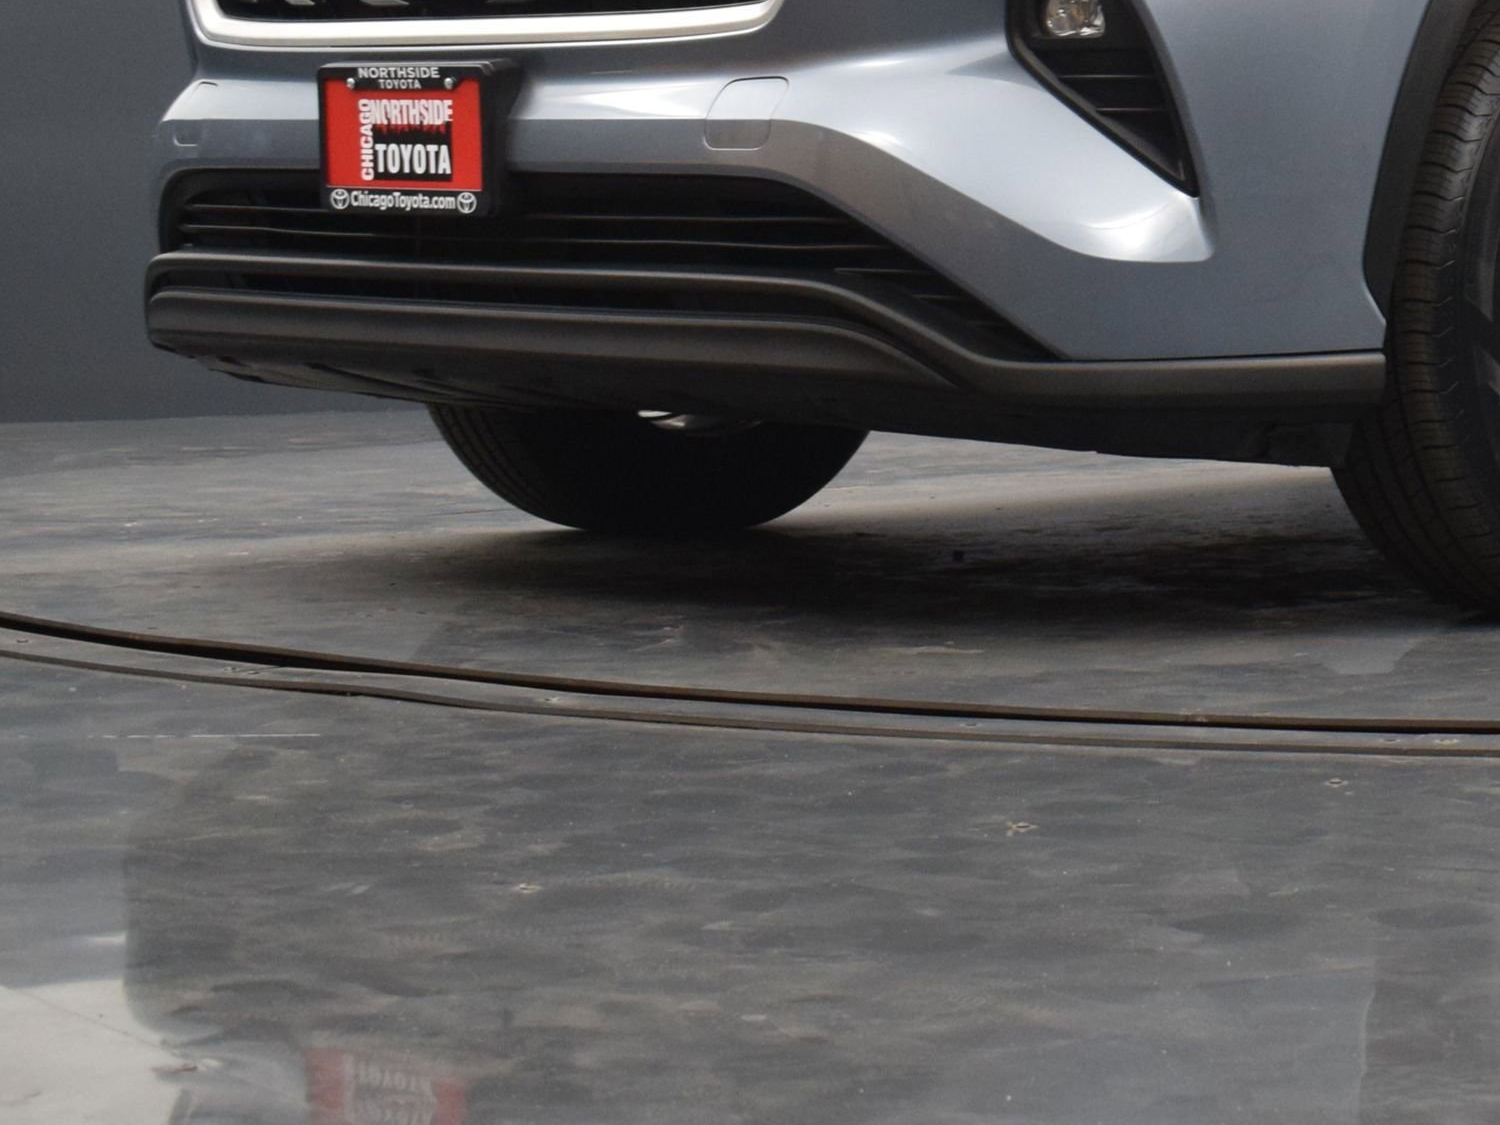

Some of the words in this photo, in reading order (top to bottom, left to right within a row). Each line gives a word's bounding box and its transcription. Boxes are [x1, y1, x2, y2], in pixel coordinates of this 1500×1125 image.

[357, 67, 441, 80] NORTHSIDE
[378, 79, 422, 90] TOYOTA
[373, 99, 453, 125] NORTHSIDE
[358, 99, 375, 181] CHICAGO
[374, 143, 452, 175] TOYOTA
[350, 191, 456, 211] ChicagoToyota.com
